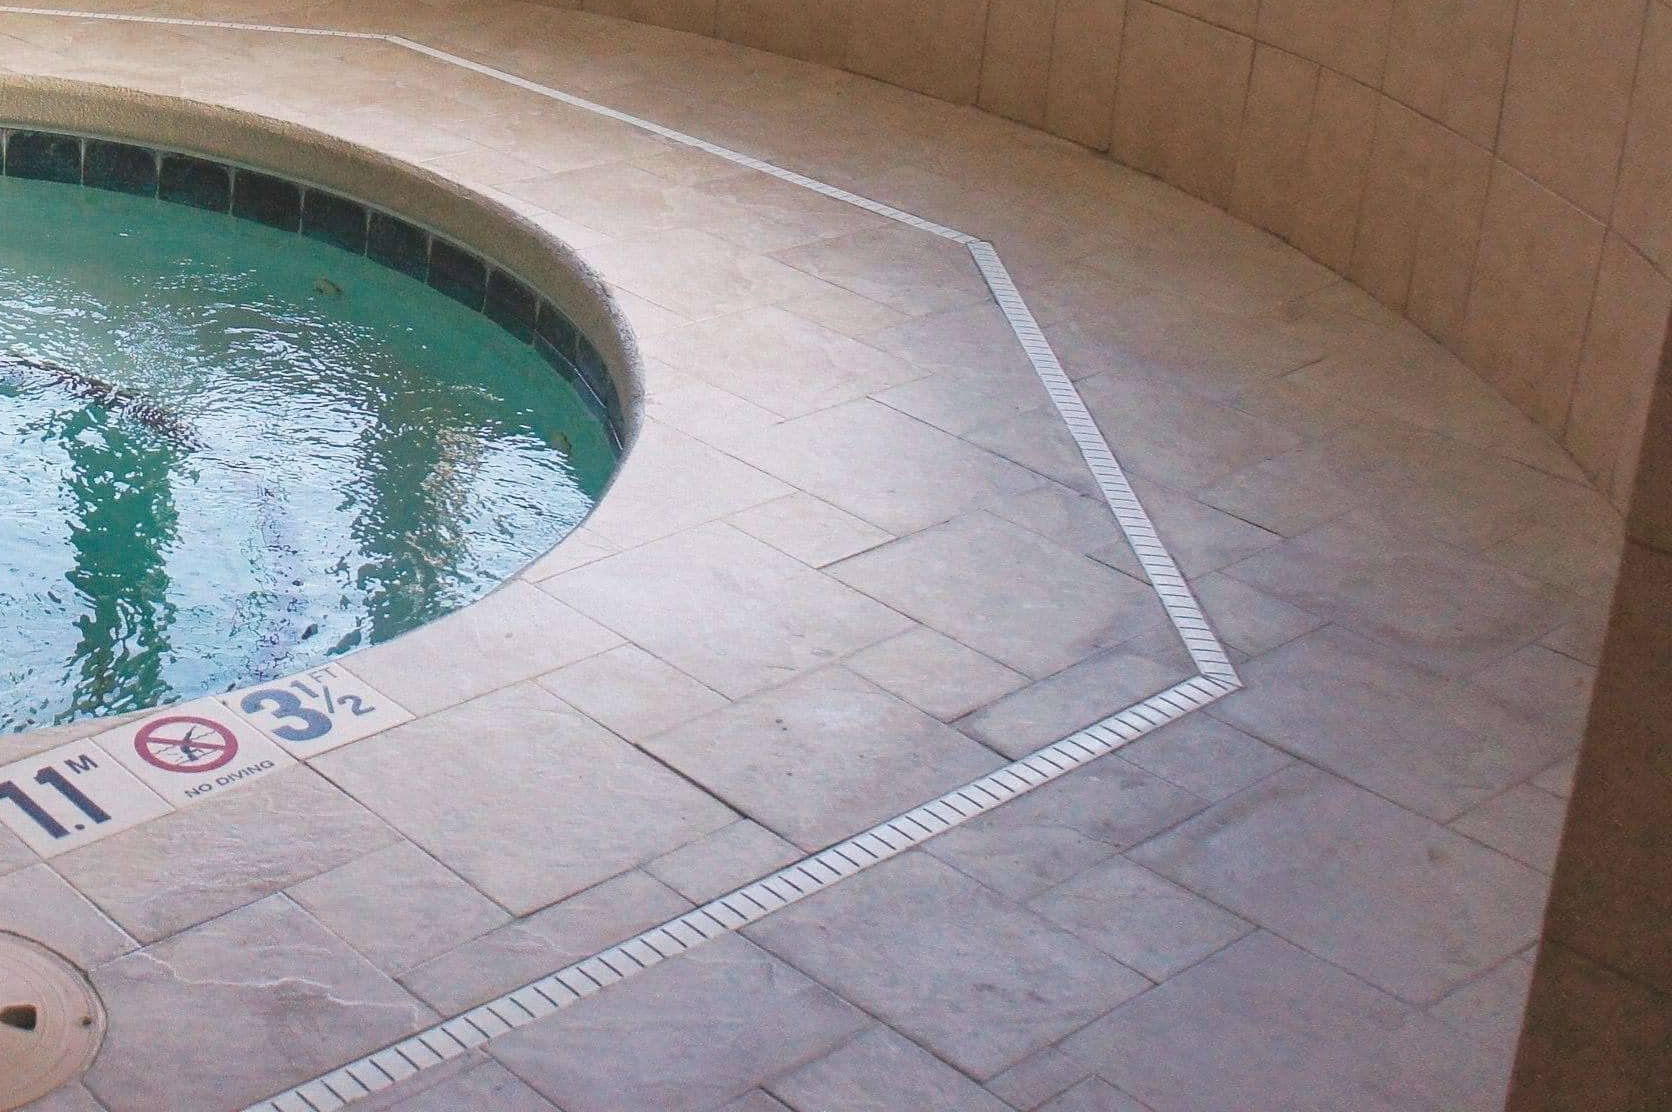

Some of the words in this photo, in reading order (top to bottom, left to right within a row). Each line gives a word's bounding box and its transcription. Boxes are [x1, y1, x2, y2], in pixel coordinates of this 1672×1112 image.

[311, 668, 338, 685] FT
[64, 753, 98, 775] M
[184, 781, 213, 799] NO
[215, 759, 275, 787] DIVING
